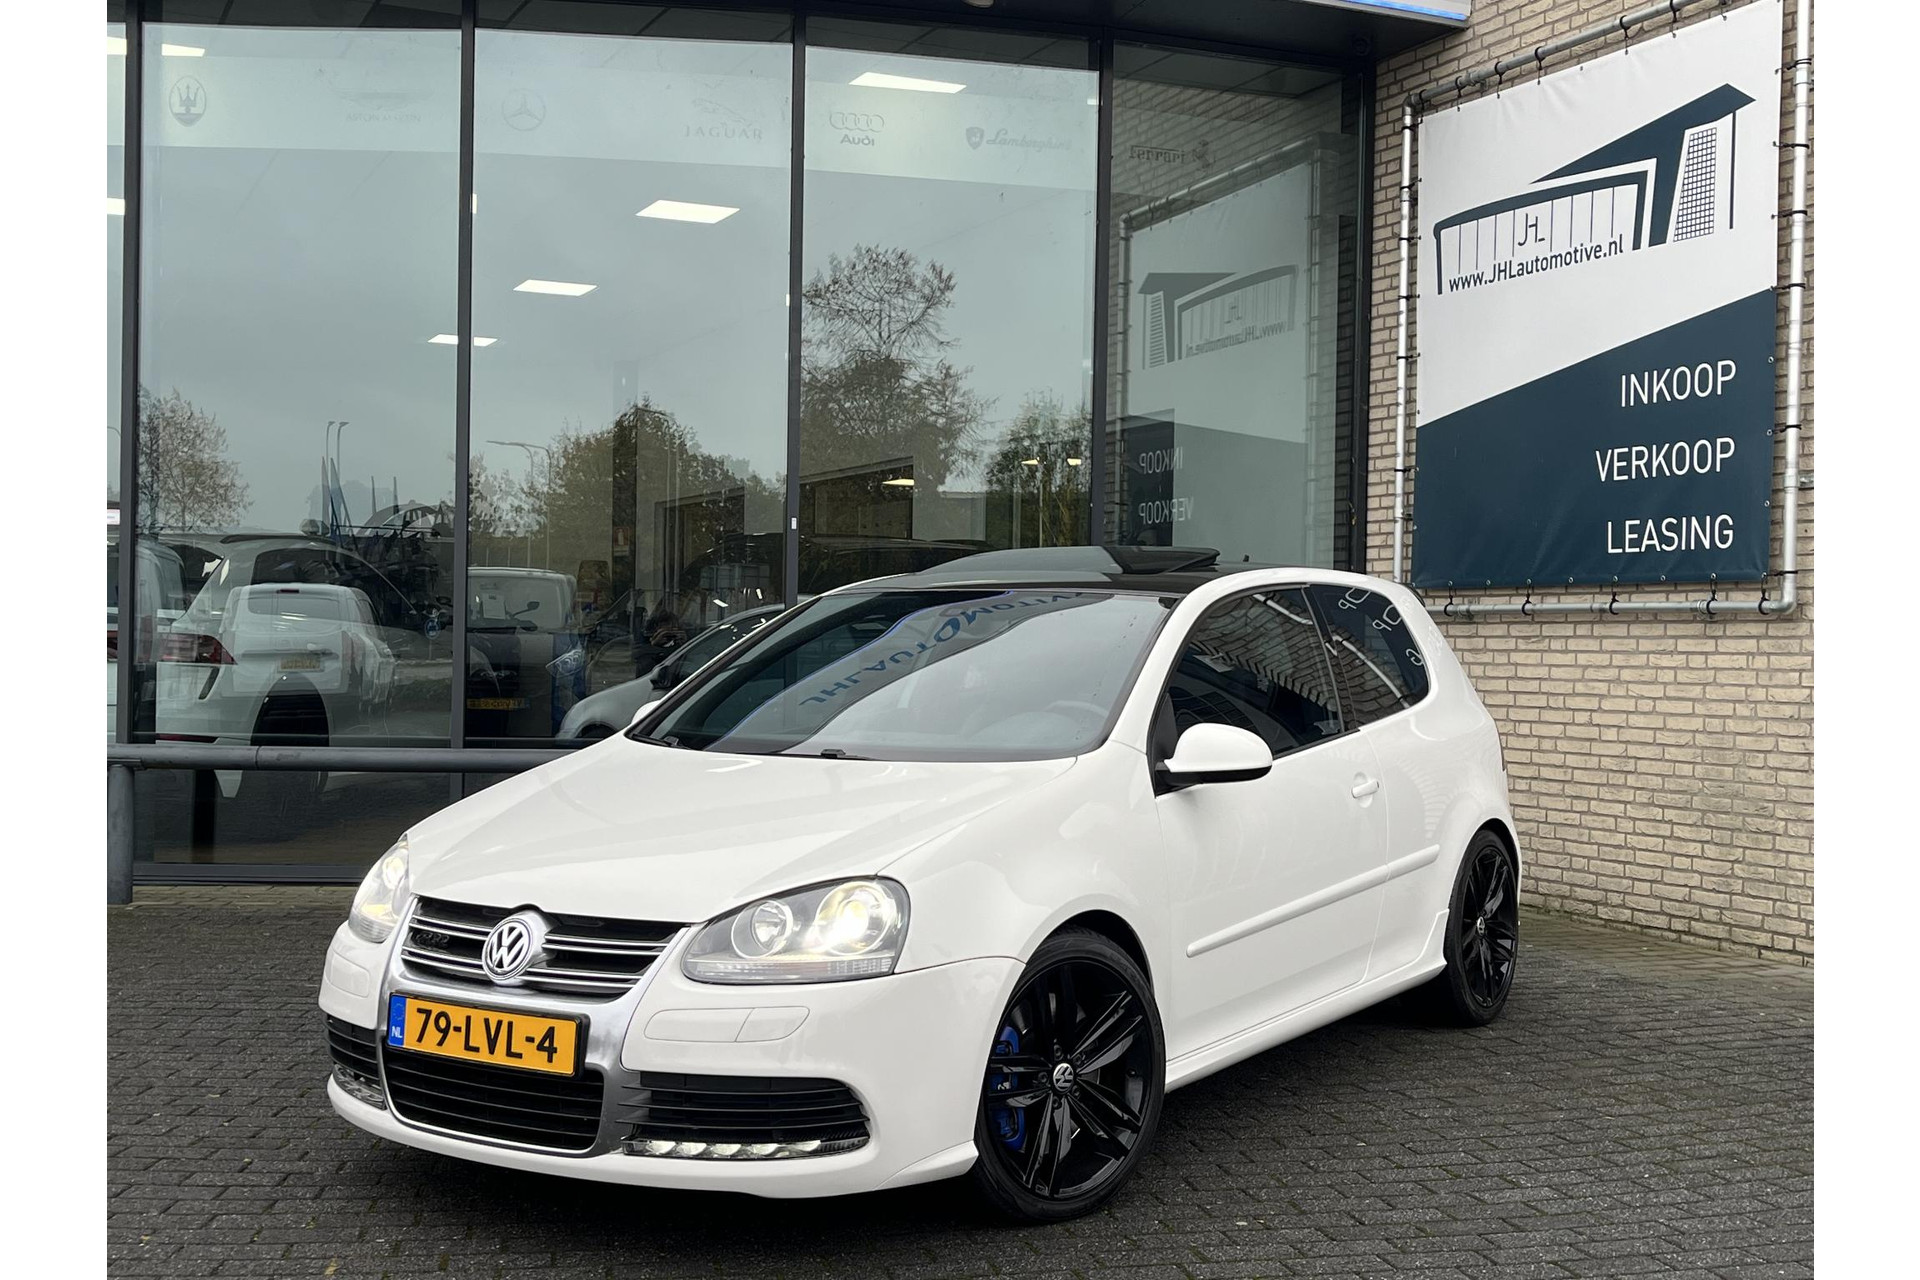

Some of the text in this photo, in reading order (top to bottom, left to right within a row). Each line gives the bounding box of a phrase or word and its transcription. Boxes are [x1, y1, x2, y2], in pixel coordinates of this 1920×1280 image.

[683, 125, 762, 140] JAGUAR
[840, 133, 875, 147] Audi
[1449, 234, 1624, 292] www.JHLautomotive.nl
[1621, 359, 1736, 408] INKOOP
[1595, 436, 1735, 482] VERKOOP
[1607, 514, 1734, 554] LEASING
[390, 1007, 558, 1064] NL 79-LVL-4
